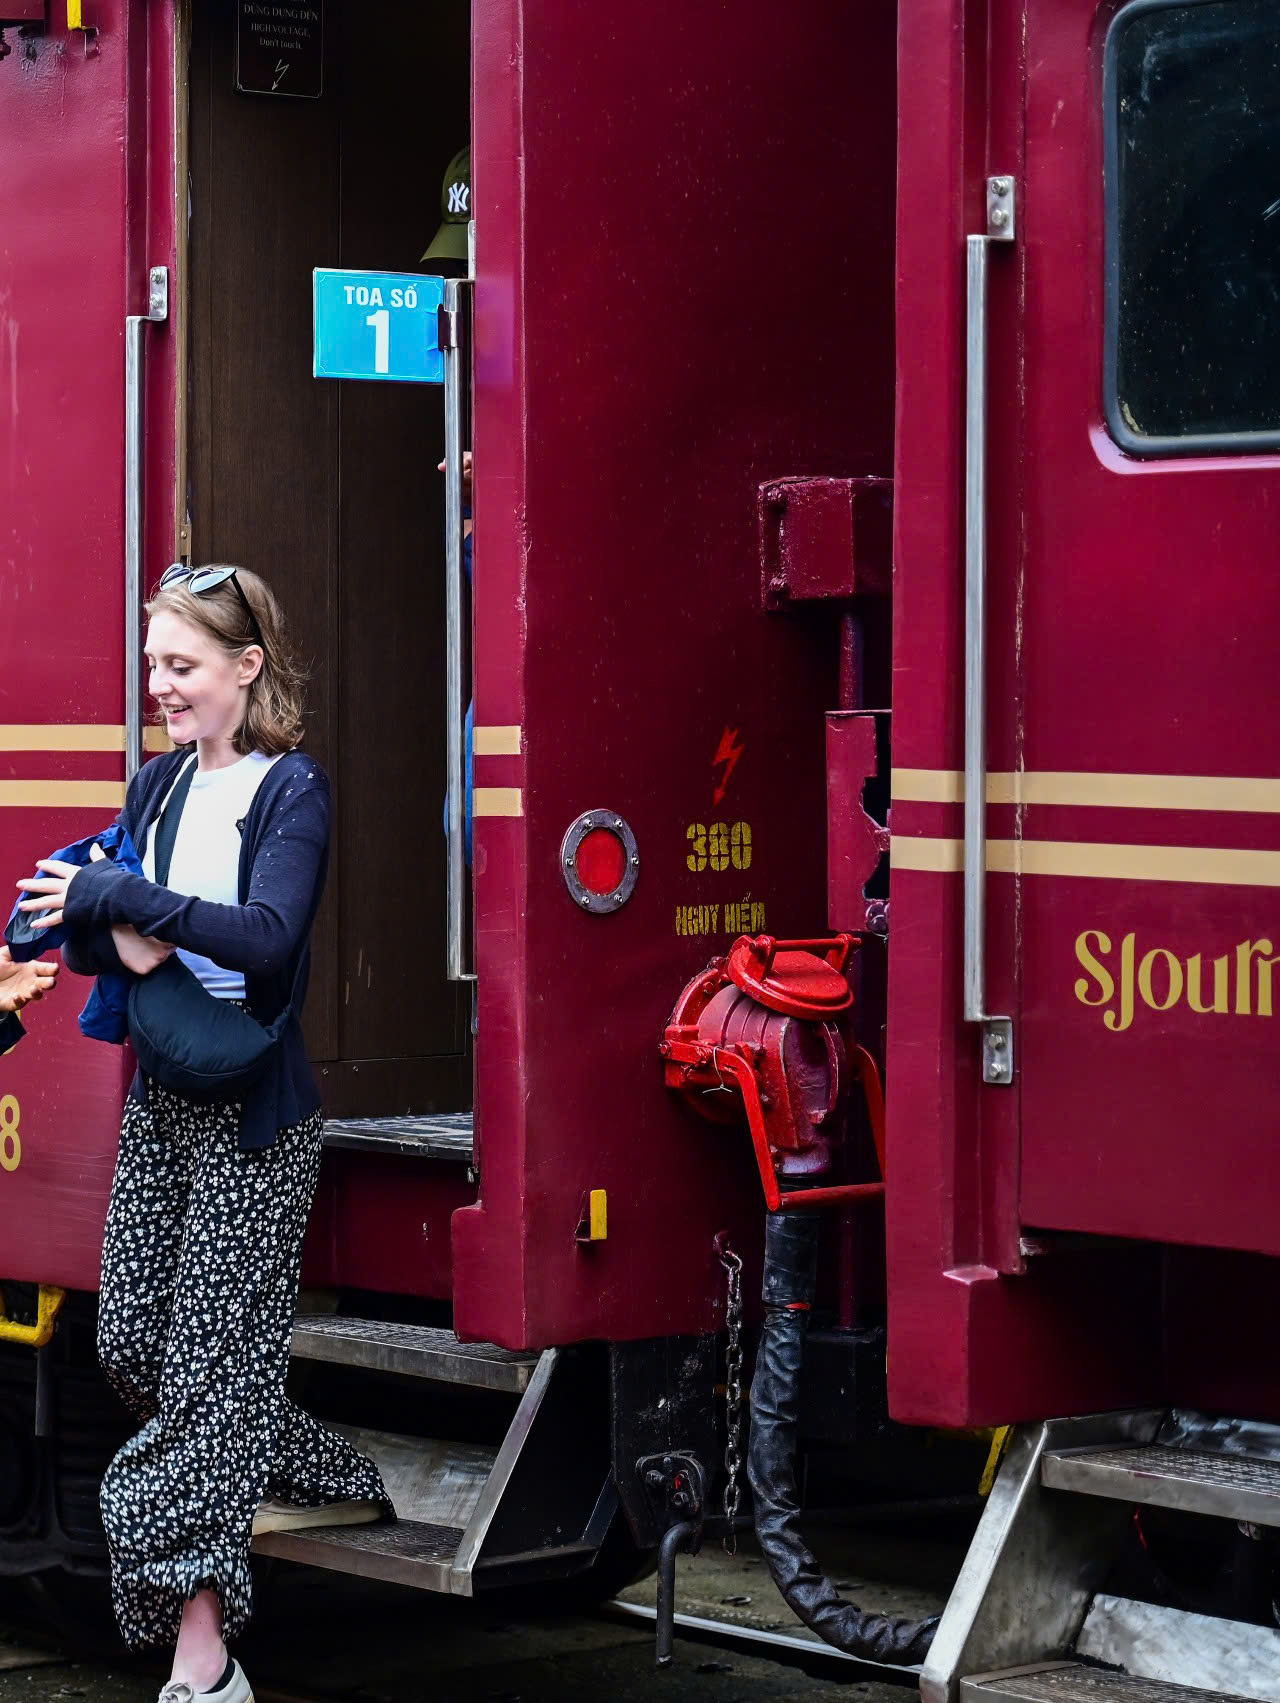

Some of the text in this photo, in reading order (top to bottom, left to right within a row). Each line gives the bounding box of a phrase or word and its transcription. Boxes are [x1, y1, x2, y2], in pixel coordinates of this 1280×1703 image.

[251, 23, 271, 32] HIGH
[343, 283, 418, 309] TOA SỐ
[366, 309, 390, 374] 1
[686, 821, 753, 872] 380
[675, 904, 720, 936] NGUY
